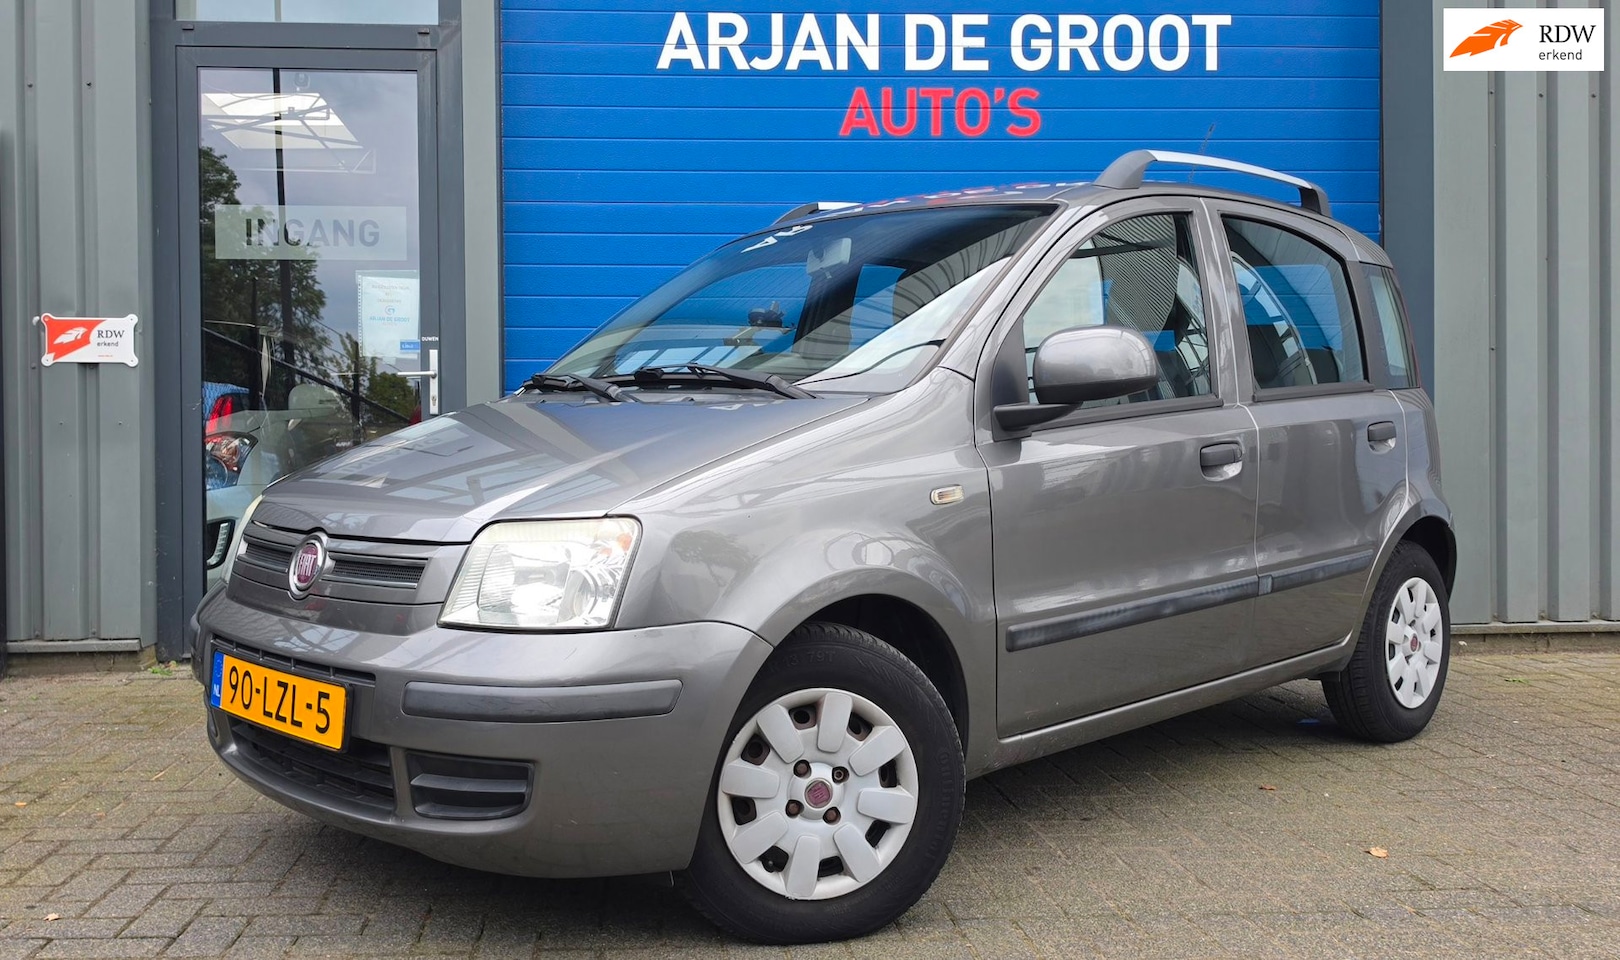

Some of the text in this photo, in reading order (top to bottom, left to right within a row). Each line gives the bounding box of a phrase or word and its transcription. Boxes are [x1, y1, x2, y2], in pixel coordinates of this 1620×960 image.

[656, 12, 1232, 72] ARJAN DE GROOT
[839, 86, 1042, 137] AUTO'S
[245, 218, 380, 247] INGANG
[97, 329, 125, 339] RDW
[212, 683, 221, 697] NL
[229, 665, 331, 734] 90-LZL-5
